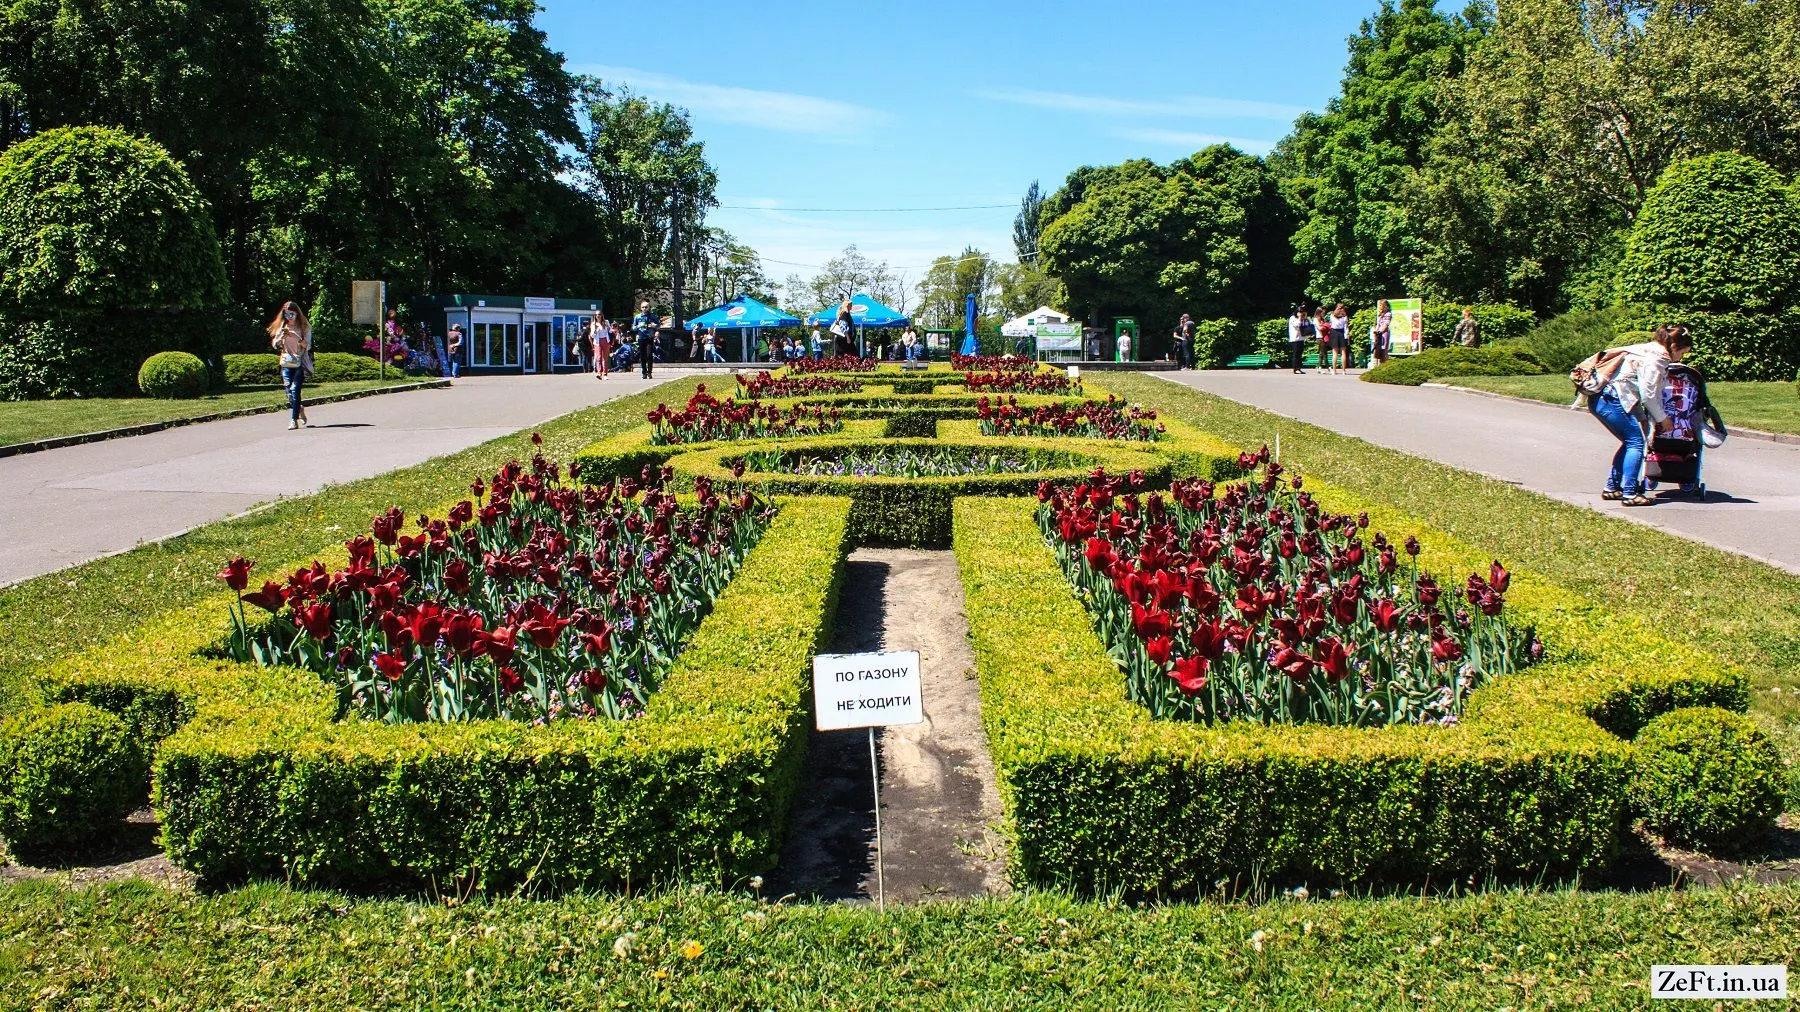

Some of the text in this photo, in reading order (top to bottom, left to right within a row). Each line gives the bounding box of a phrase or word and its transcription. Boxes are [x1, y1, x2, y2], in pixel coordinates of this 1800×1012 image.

[836, 668, 908, 682] ПО ГАЗОНУ
[837, 696, 911, 711] НЕ ХОДИТИ
